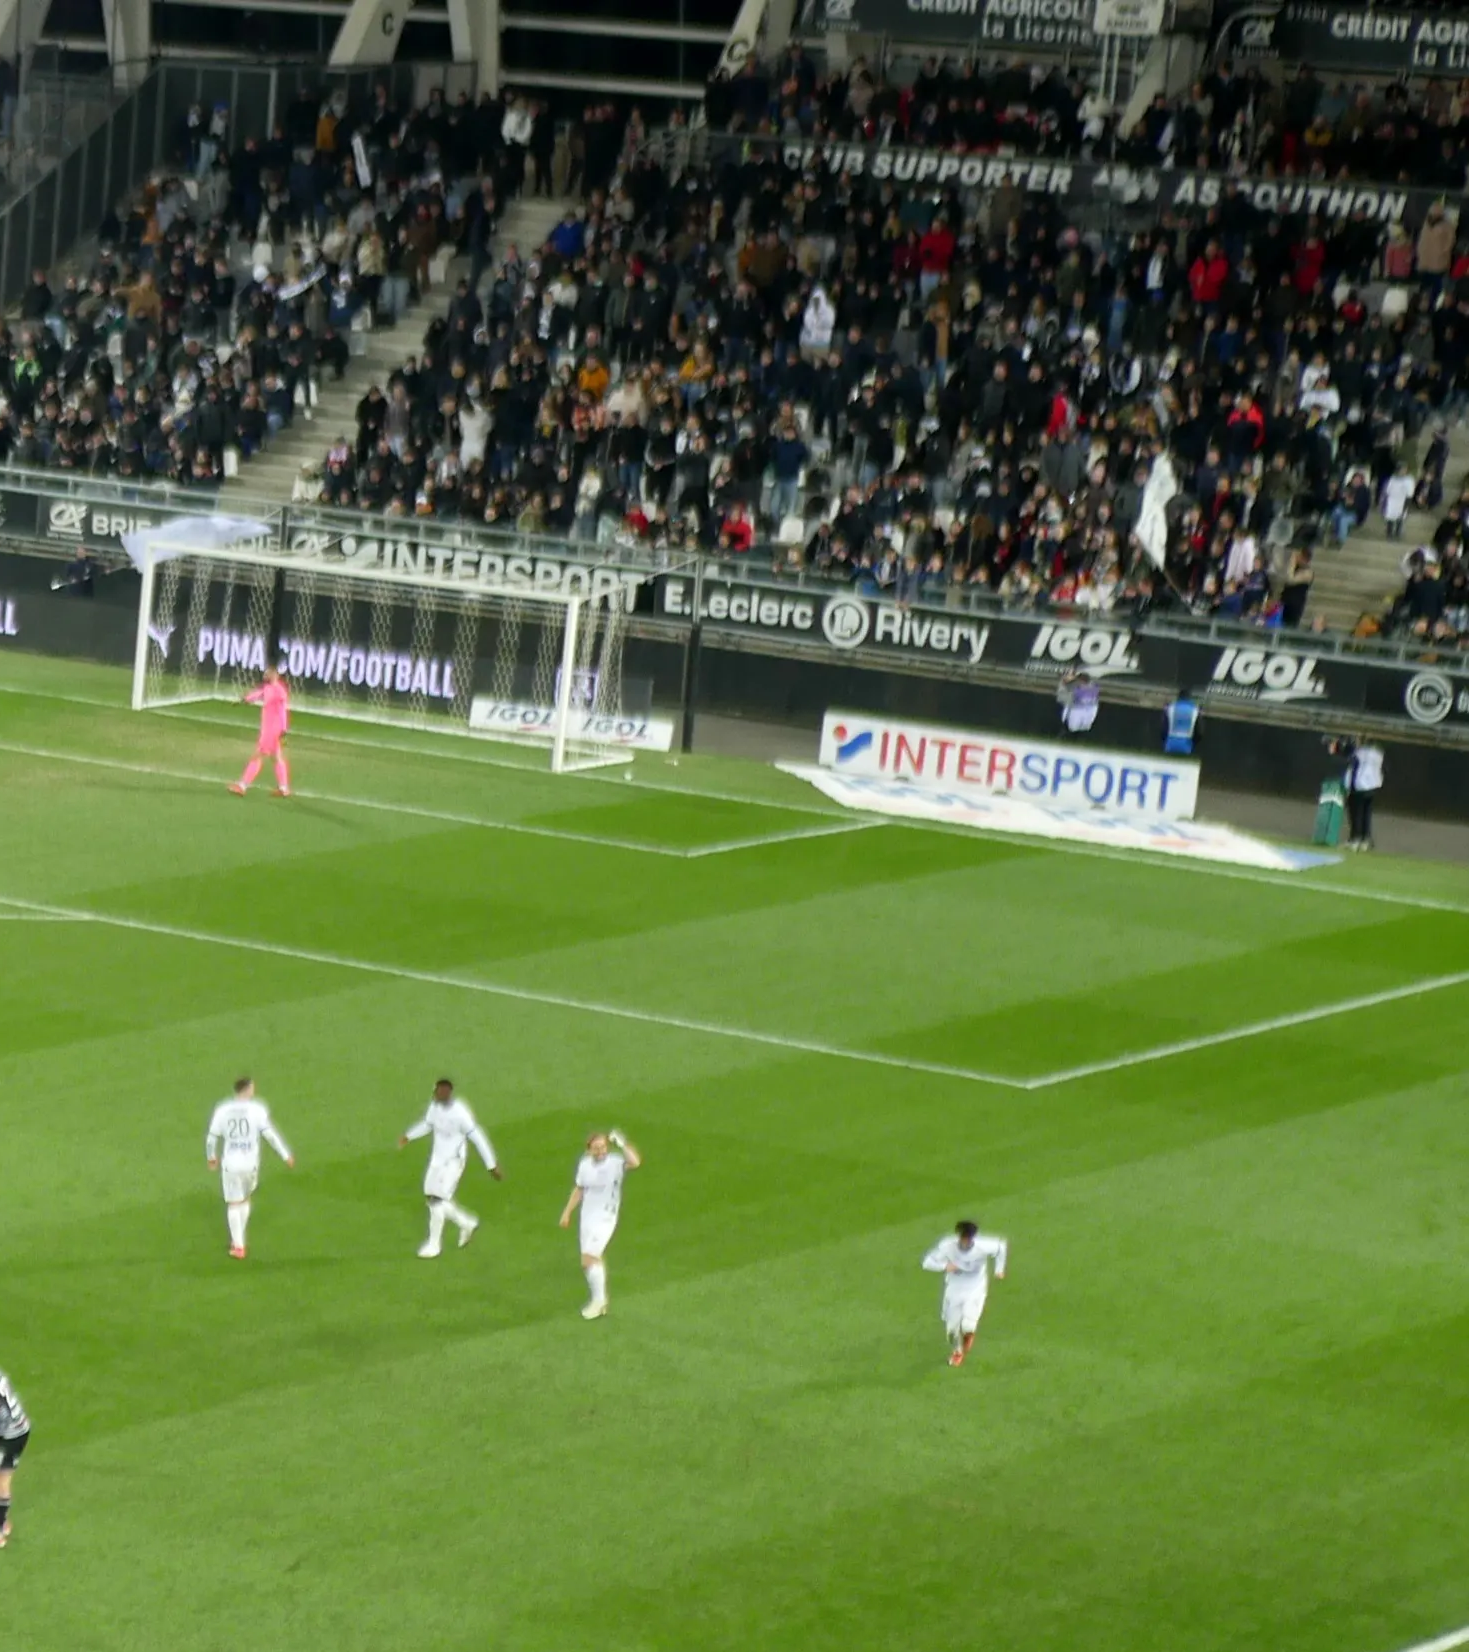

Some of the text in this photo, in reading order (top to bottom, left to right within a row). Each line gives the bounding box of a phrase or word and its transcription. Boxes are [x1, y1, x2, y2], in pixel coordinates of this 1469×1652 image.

[1331, 9, 1411, 42] CRÉDIT
[871, 151, 1074, 195] SUPPORTER
[383, 541, 645, 614] INTERSPORT
[875, 606, 989, 663] Rivery
[199, 627, 458, 700] PUMACOM/FOOTBALL
[487, 704, 554, 727] IGOL
[582, 717, 649, 740] IGOL
[879, 730, 1182, 812] INTERSPORT
[227, 1117, 250, 1139] 20
